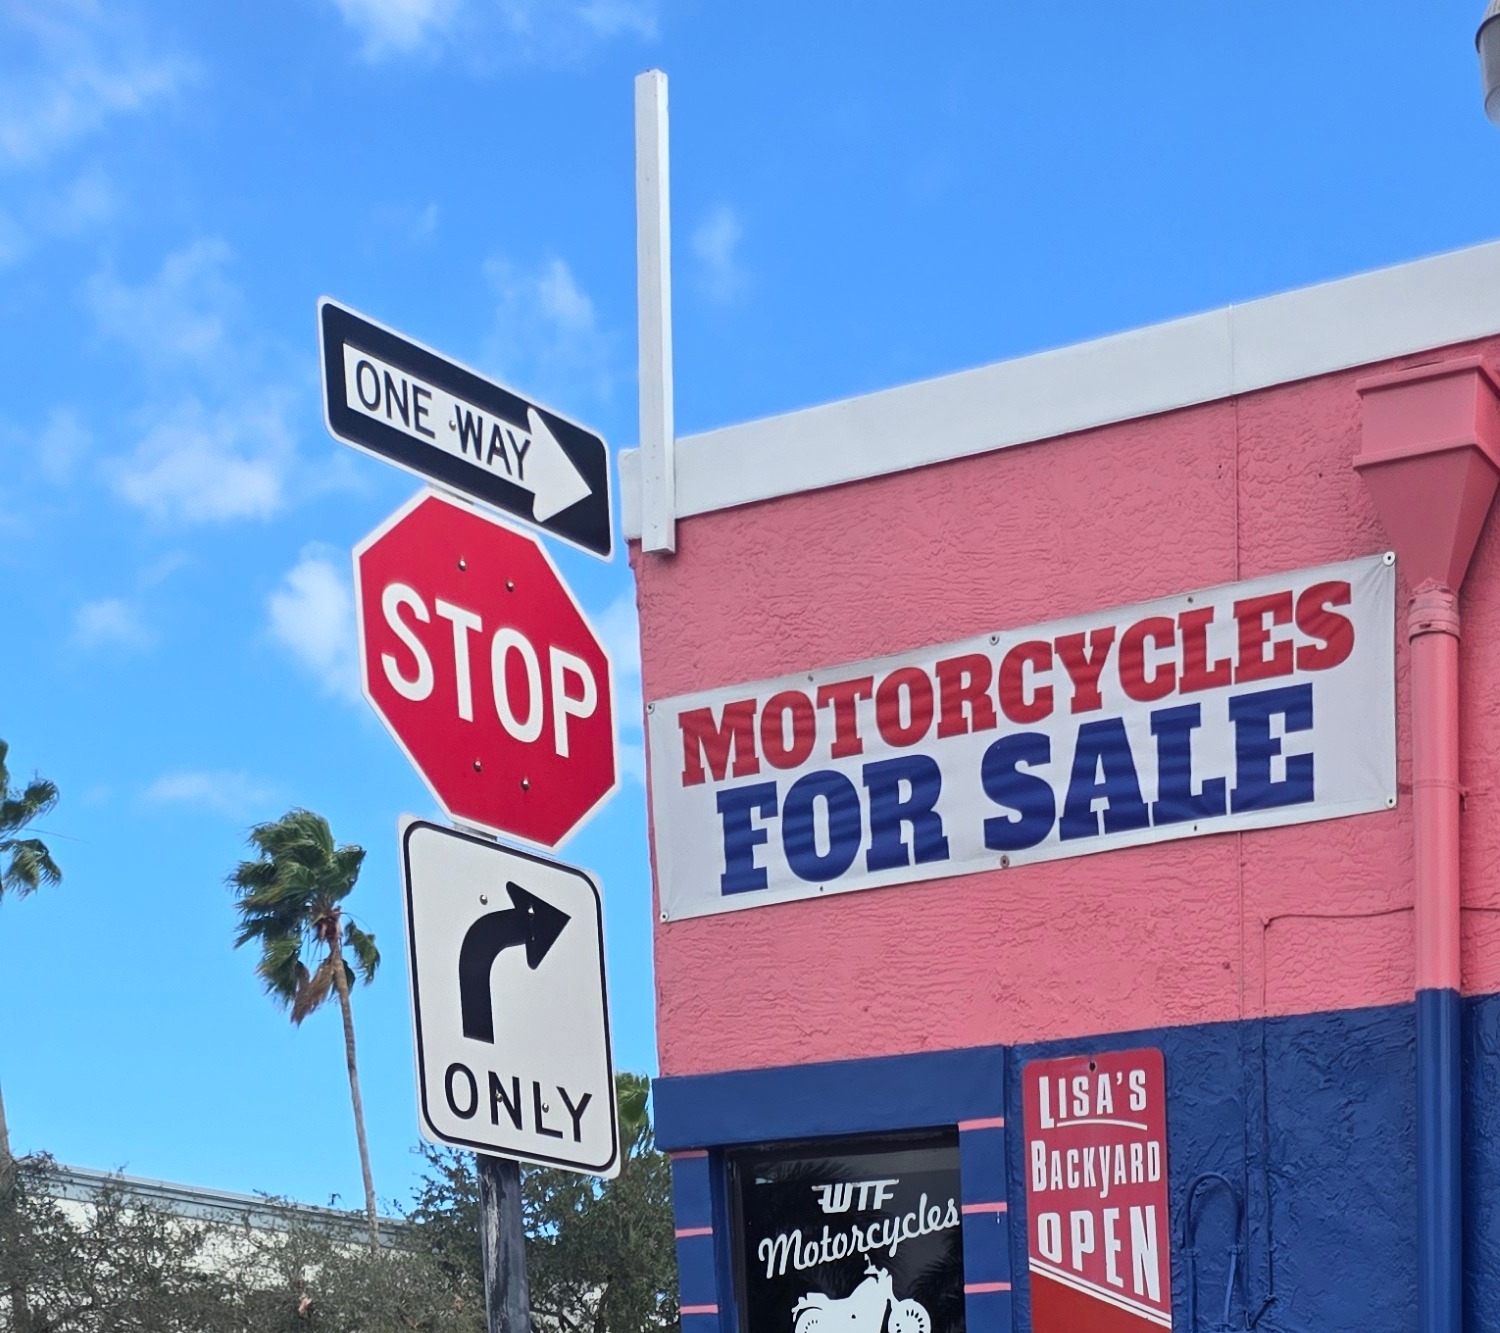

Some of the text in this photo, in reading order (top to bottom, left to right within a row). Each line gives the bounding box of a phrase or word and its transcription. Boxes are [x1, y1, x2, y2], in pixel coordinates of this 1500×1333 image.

[356, 360, 531, 481] ONE WAY
[381, 583, 598, 758] STOP
[678, 581, 1355, 787] MOTORCYCLES
[716, 682, 1315, 895] FOR SALE
[444, 1063, 593, 1142] ONLY
[1039, 1069, 1147, 1129] LISA'S
[758, 1193, 960, 1279] Motorcycles
[811, 1178, 899, 1214] WTF
[1037, 1205, 1161, 1302] OPEN
